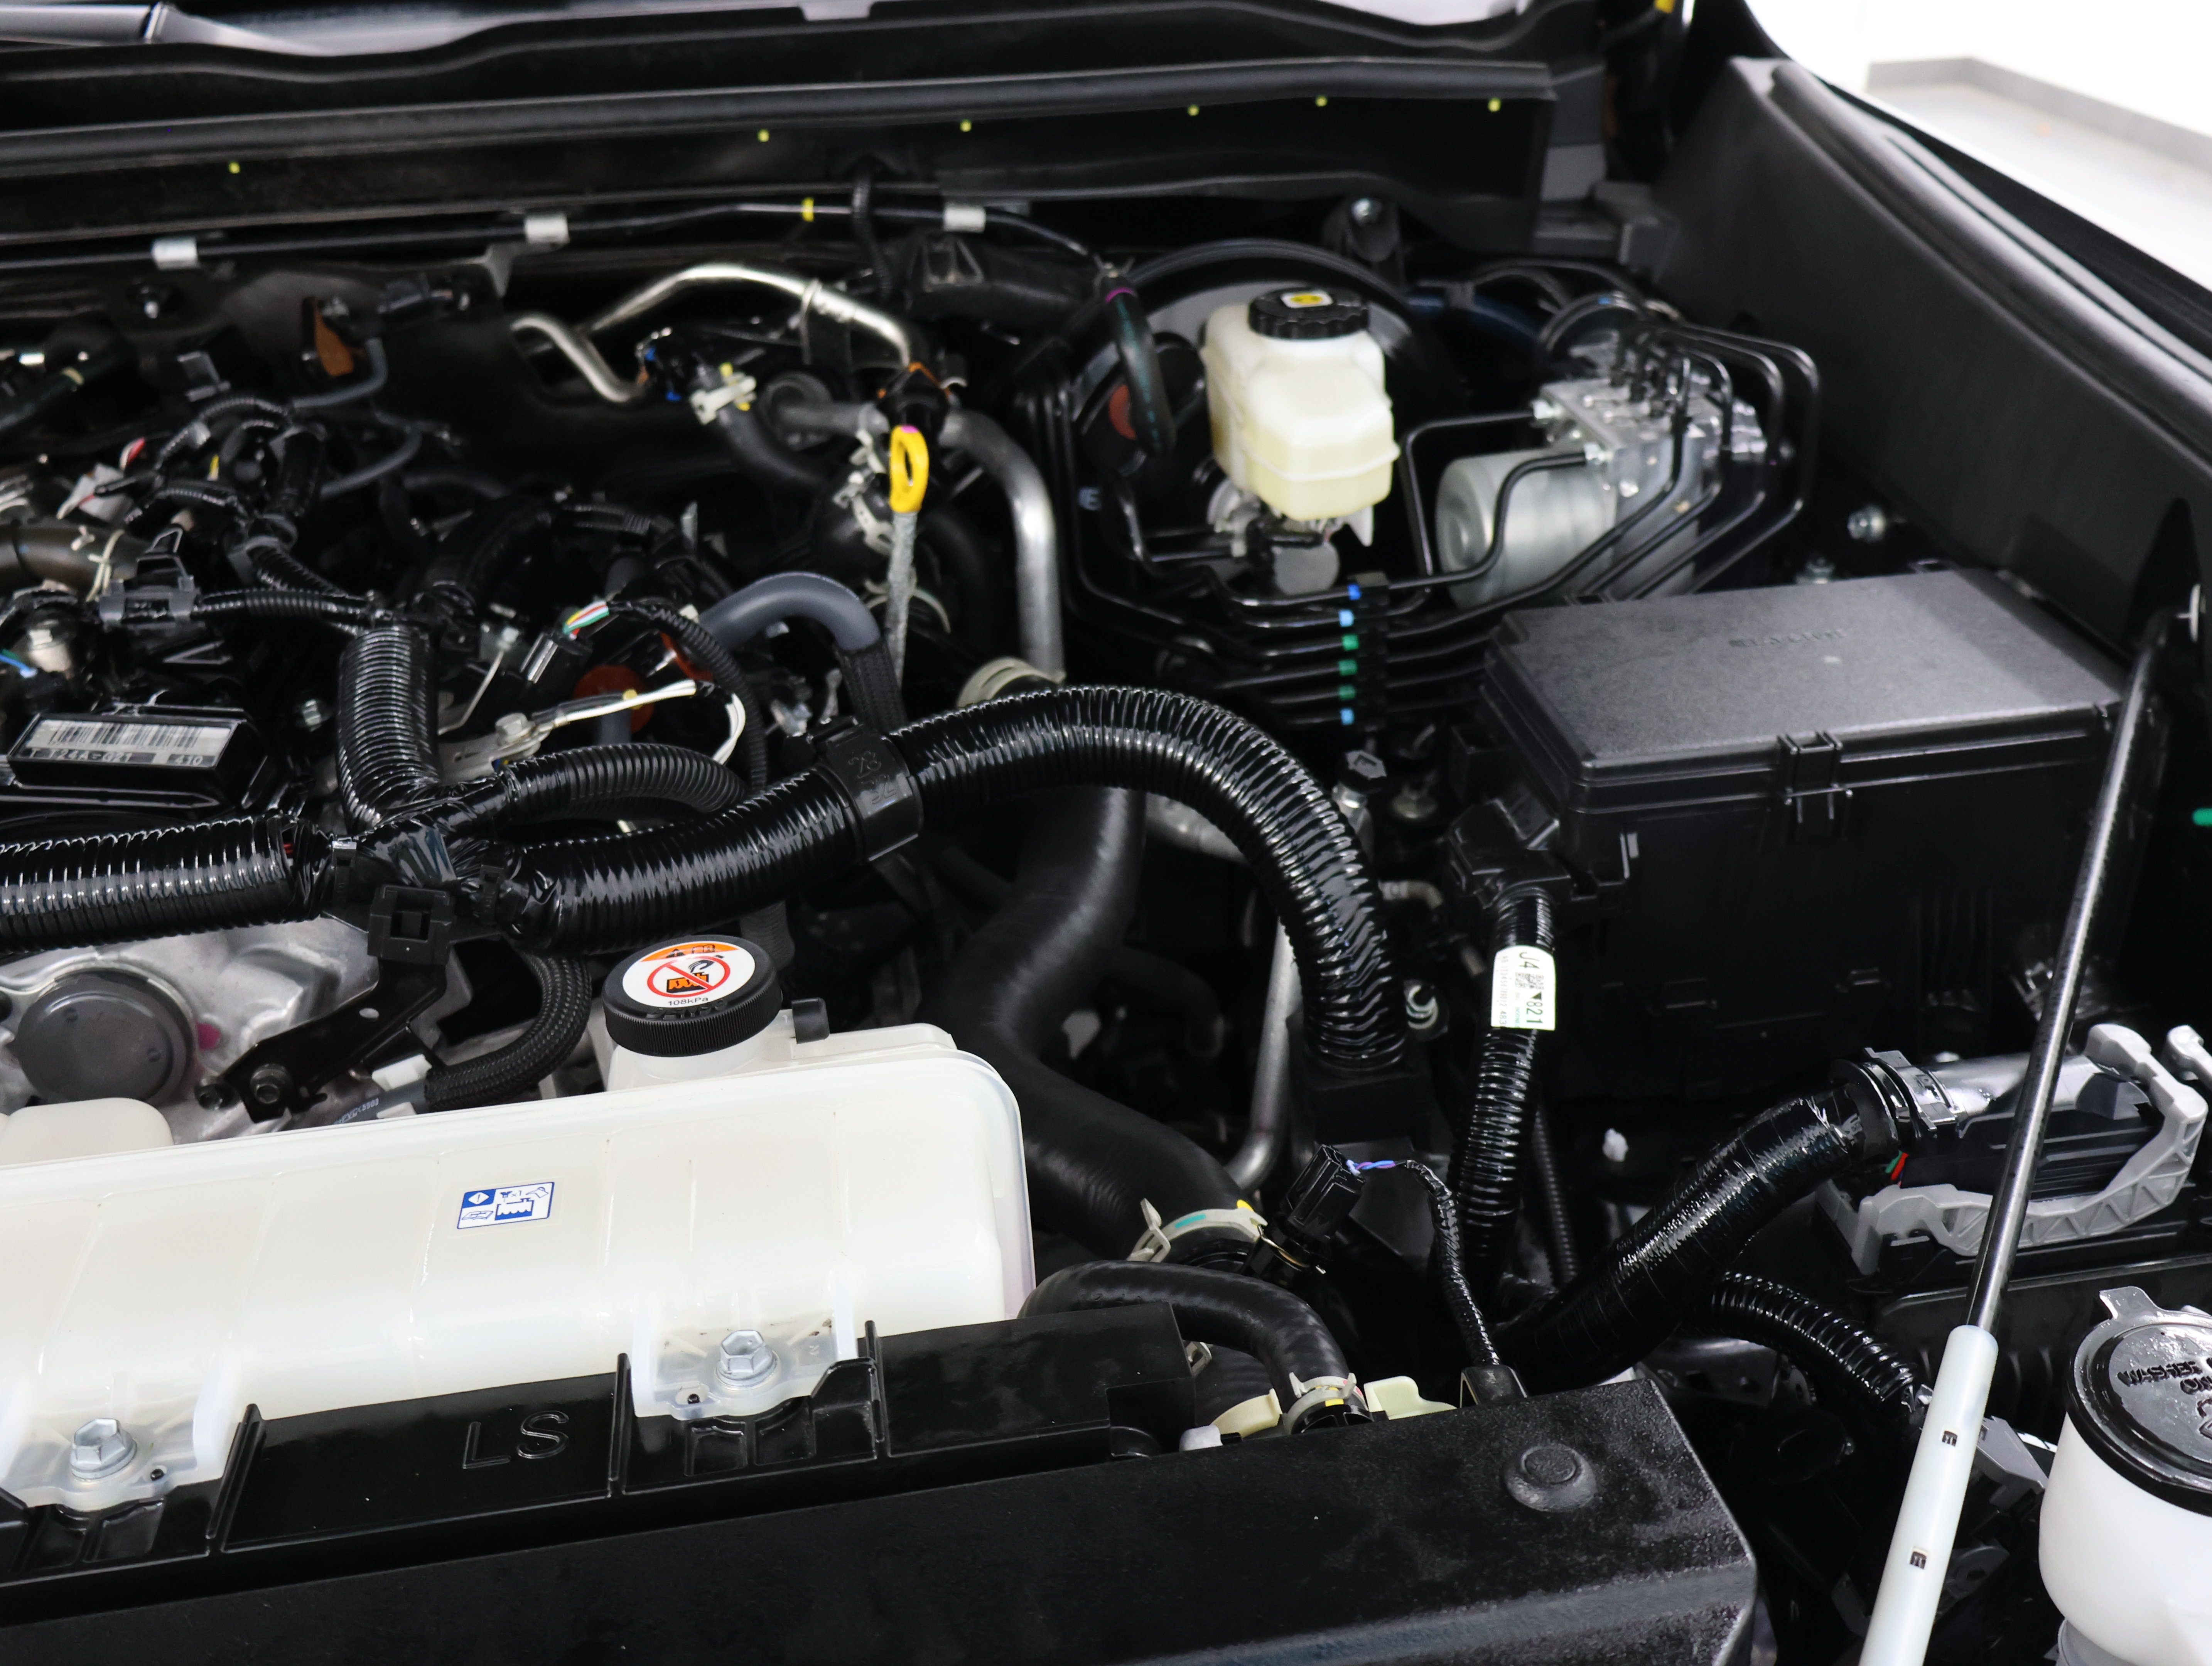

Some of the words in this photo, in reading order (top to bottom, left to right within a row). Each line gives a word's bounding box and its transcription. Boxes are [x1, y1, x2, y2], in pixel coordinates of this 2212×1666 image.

[1519, 951, 1540, 969] J4
[668, 997, 709, 1006] 108kPa
[1526, 1001, 1543, 1024] 821
